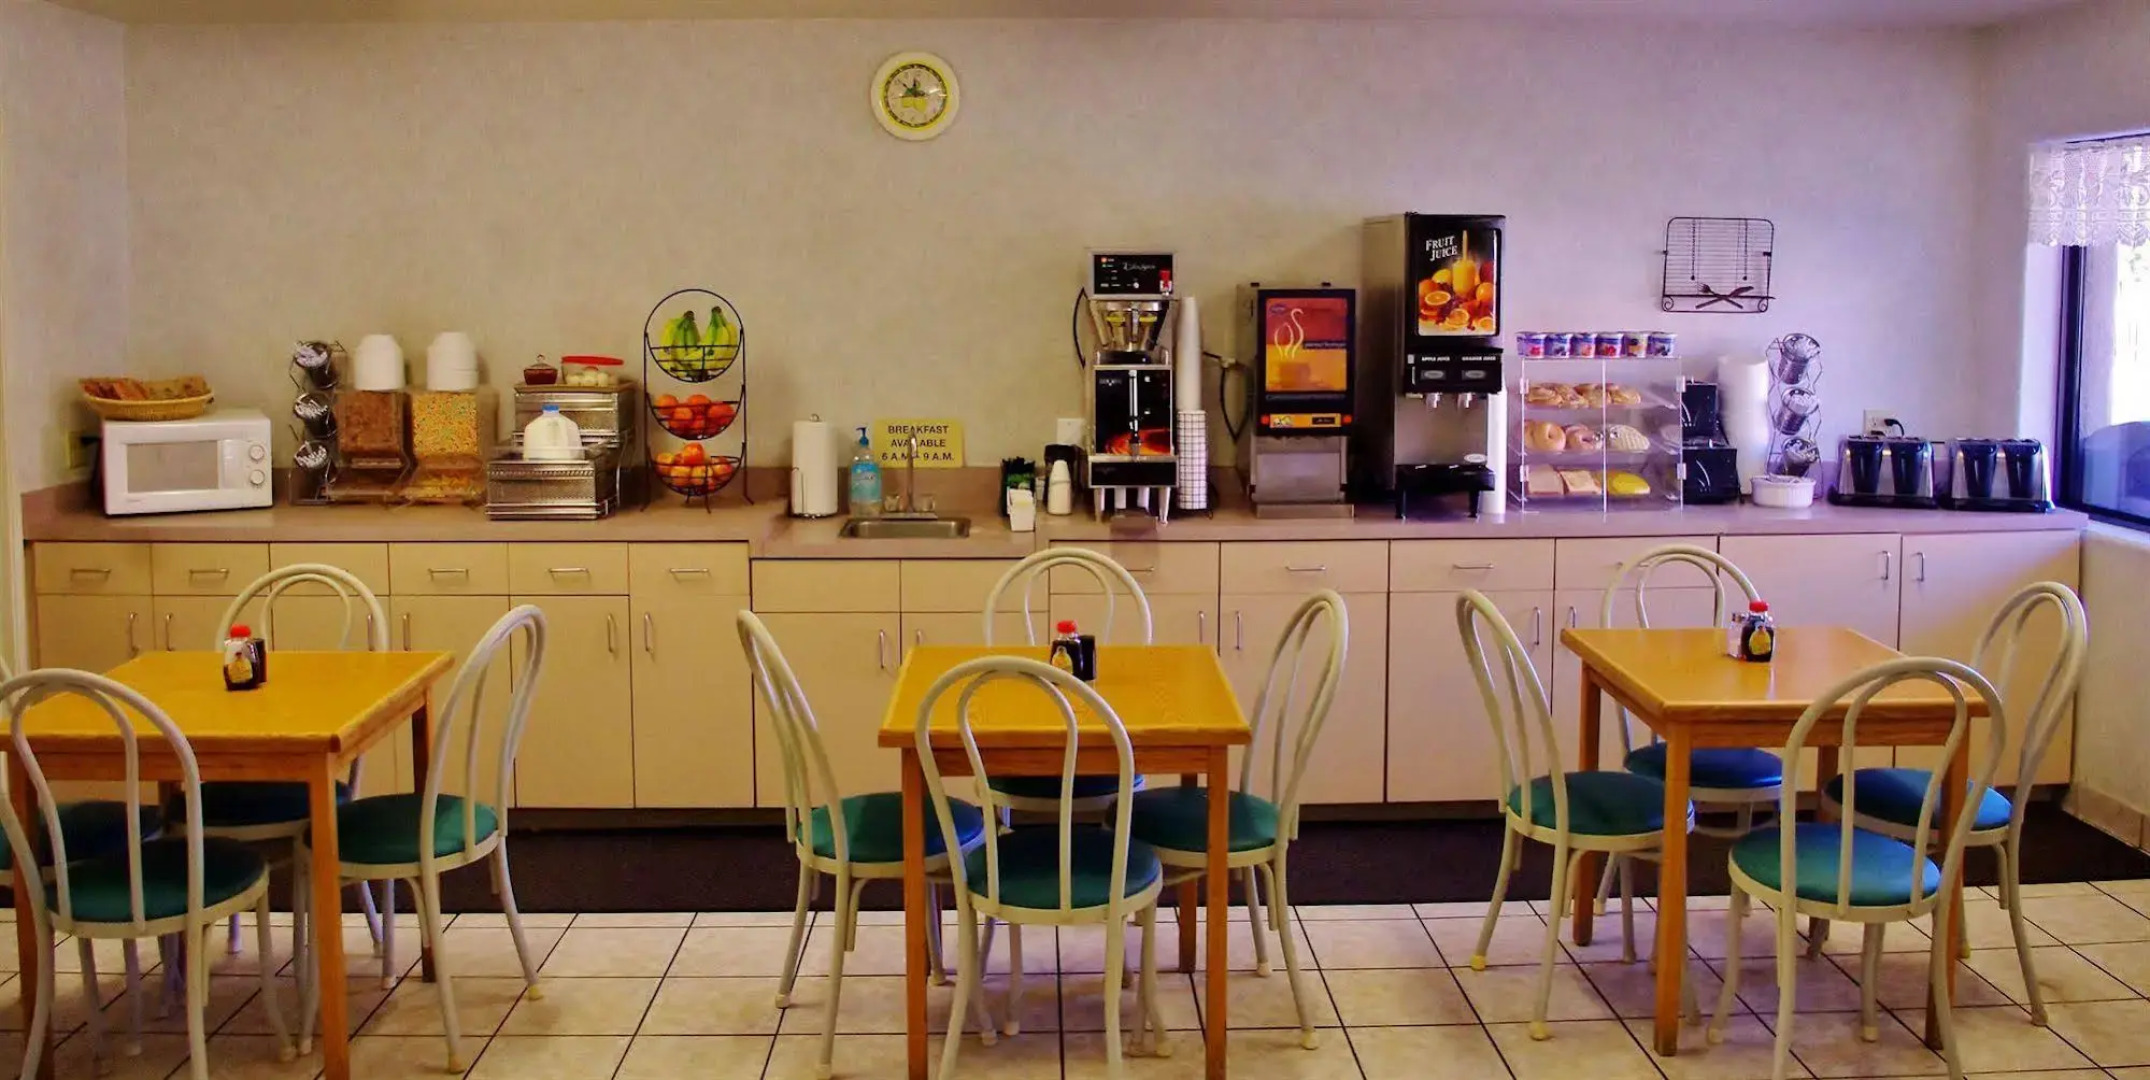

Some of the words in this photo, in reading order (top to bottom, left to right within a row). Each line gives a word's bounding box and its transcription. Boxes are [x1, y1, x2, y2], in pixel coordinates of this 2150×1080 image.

[1425, 235, 1455, 251] FRUIT
[1430, 245, 1458, 262] JUICE
[887, 425, 949, 434] BREAKFAST
[891, 439, 946, 448] AVAABLE
[881, 452, 888, 461] 6
[923, 452, 929, 461] 9
[932, 452, 955, 461] A.M.
